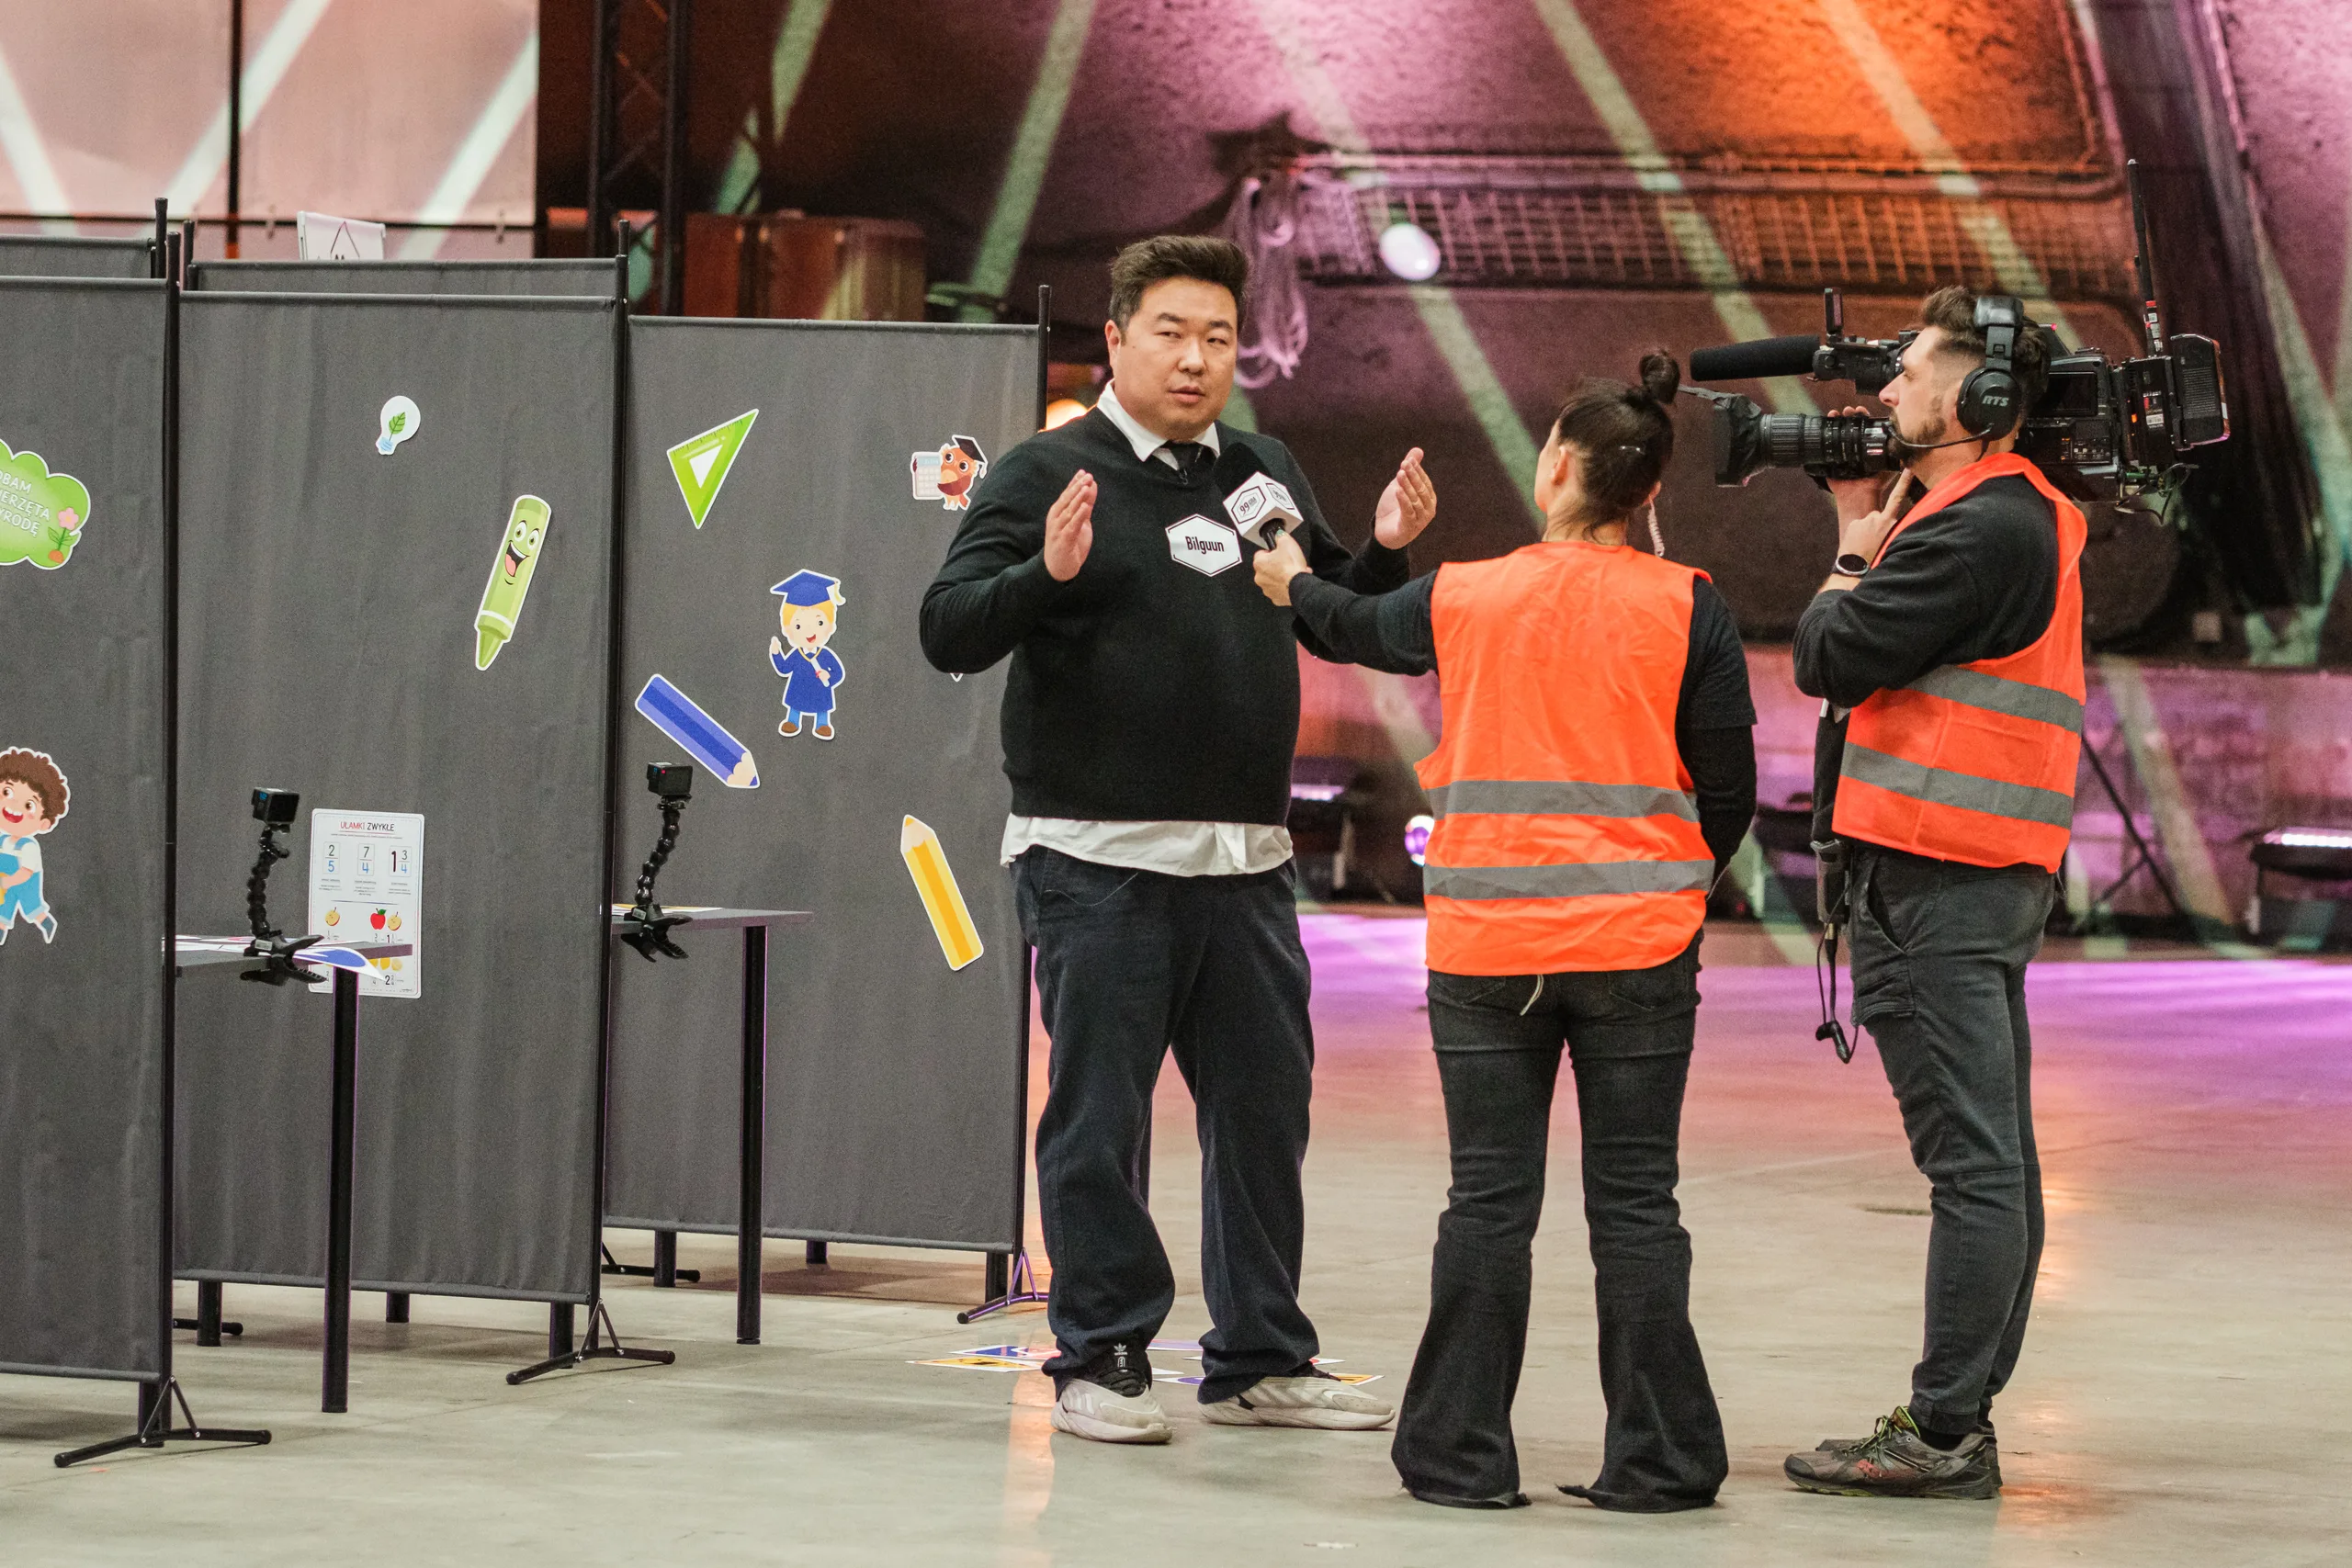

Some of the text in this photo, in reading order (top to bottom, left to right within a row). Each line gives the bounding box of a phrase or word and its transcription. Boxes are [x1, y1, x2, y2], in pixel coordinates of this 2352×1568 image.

[1982, 395, 2009, 407] RTS
[1240, 502, 1250, 514] 99
[1185, 536, 1225, 555] Bilguun
[367, 822, 395, 831] ZWYKŁE
[328, 844, 335, 856] 2
[363, 846, 370, 858] 7
[327, 860, 334, 873] 5
[391, 850, 408, 873] 1 3
[362, 863, 369, 874] 4
[401, 863, 407, 874] 4
[385, 975, 390, 986] 2
